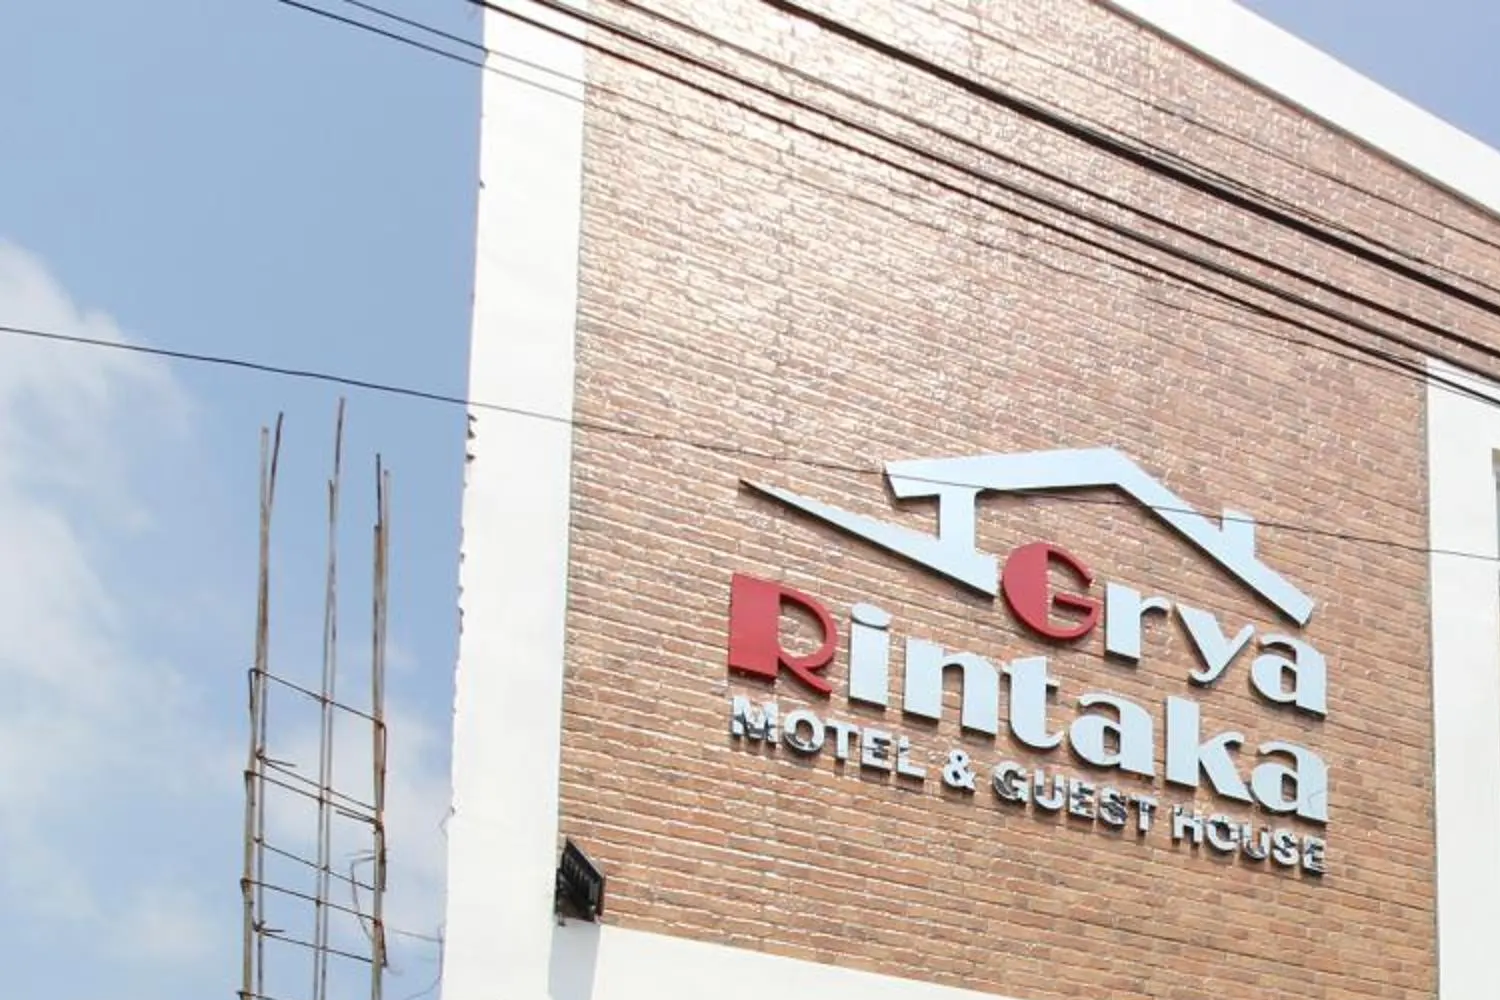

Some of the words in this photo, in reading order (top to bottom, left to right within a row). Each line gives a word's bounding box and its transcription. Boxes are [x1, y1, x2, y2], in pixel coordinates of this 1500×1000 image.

[728, 572, 1329, 824] Rintaka
[1000, 541, 1328, 718] Grya
[731, 695, 928, 780] MOTEL
[942, 749, 977, 794] &
[992, 760, 1160, 835] GUEST
[1172, 804, 1328, 876] HOUSE
